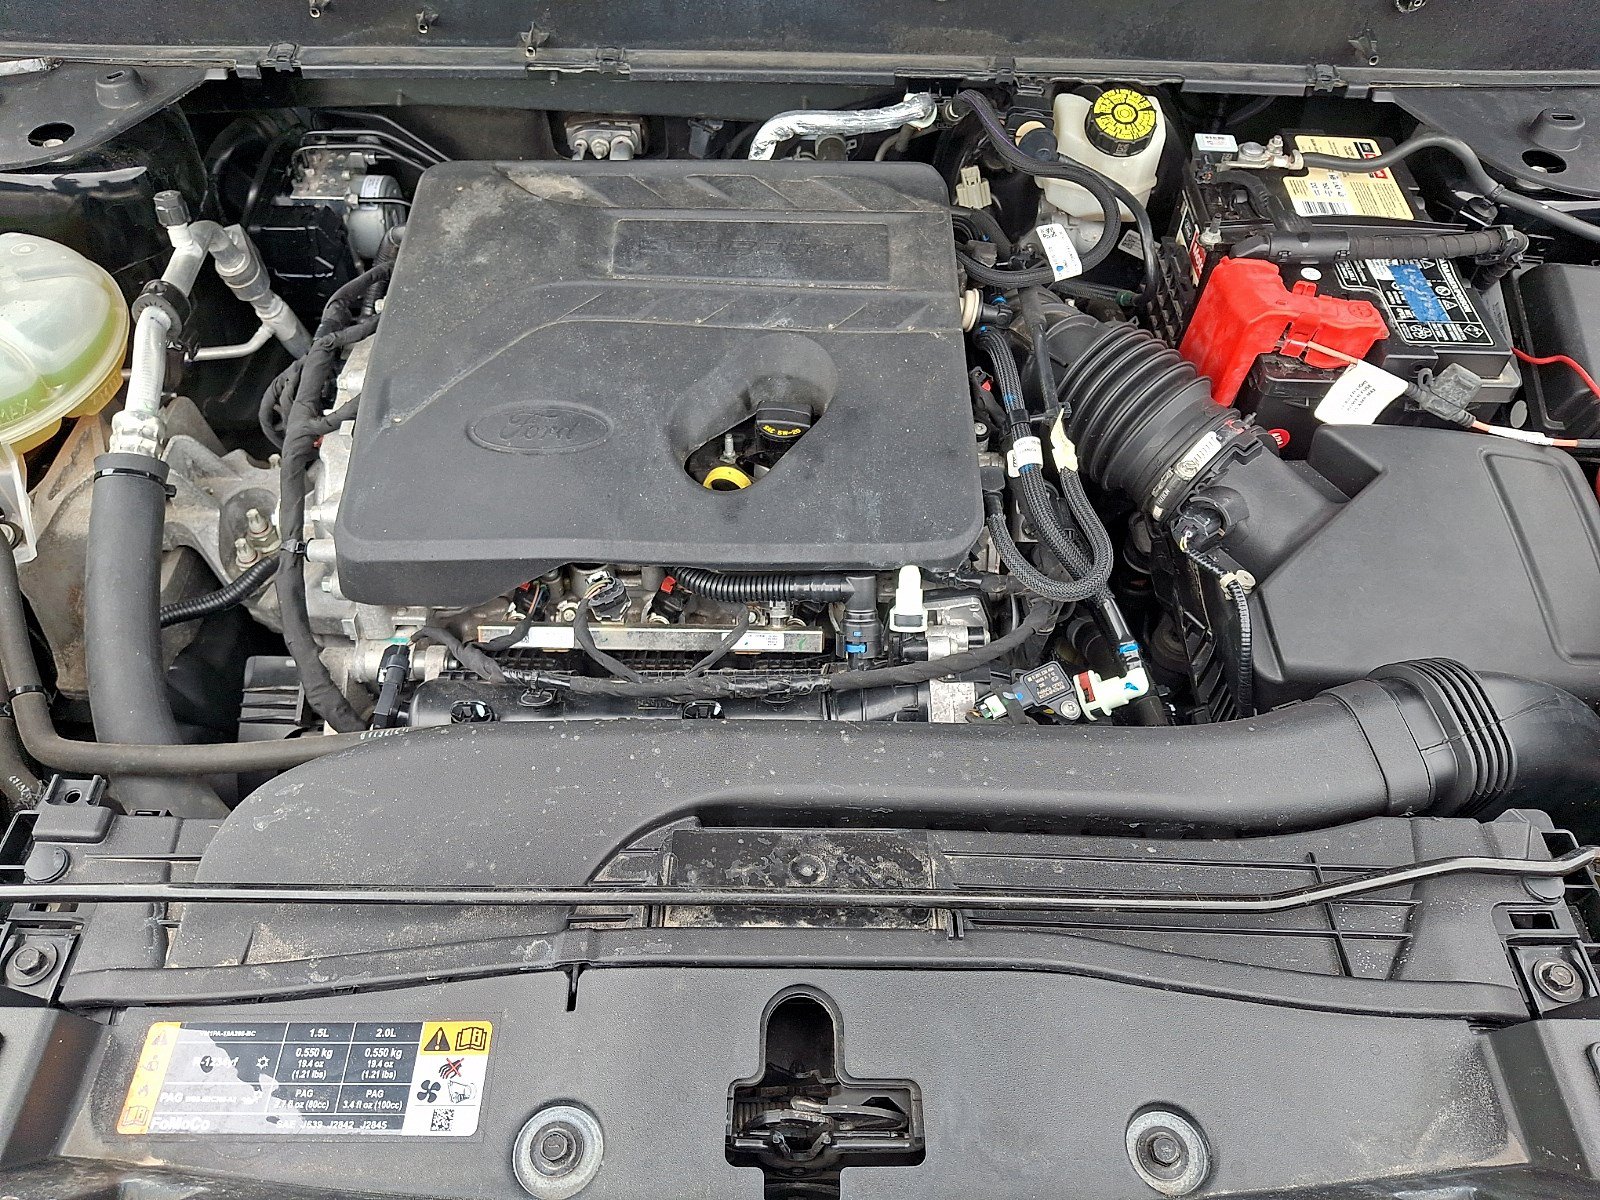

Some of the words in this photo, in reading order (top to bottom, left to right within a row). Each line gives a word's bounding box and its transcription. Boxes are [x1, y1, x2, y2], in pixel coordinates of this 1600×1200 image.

[309, 1028, 330, 1038] 1.5L
[375, 1028, 397, 1038] 2.0L
[295, 1048, 321, 1058] 0.550
[321, 1048, 334, 1060] kg
[364, 1048, 390, 1058] 0.550
[390, 1048, 403, 1060] kg
[298, 1060, 314, 1068] 19.4
[367, 1060, 383, 1068] 19.4
[291, 1070, 312, 1080] (1.21
[311, 1070, 327, 1080] lbs)
[361, 1070, 382, 1080] (1.21
[382, 1070, 397, 1080] lbs)
[295, 1089, 314, 1098] PAG
[365, 1089, 385, 1098] PAG
[295, 1101, 305, 1109] oz
[342, 1101, 356, 1109] 3.4
[374, 1100, 403, 1111] (100cc)
[150, 1117, 211, 1131] FoMoCo
[326, 1120, 355, 1129] J2842
[360, 1120, 388, 1130] J2845
